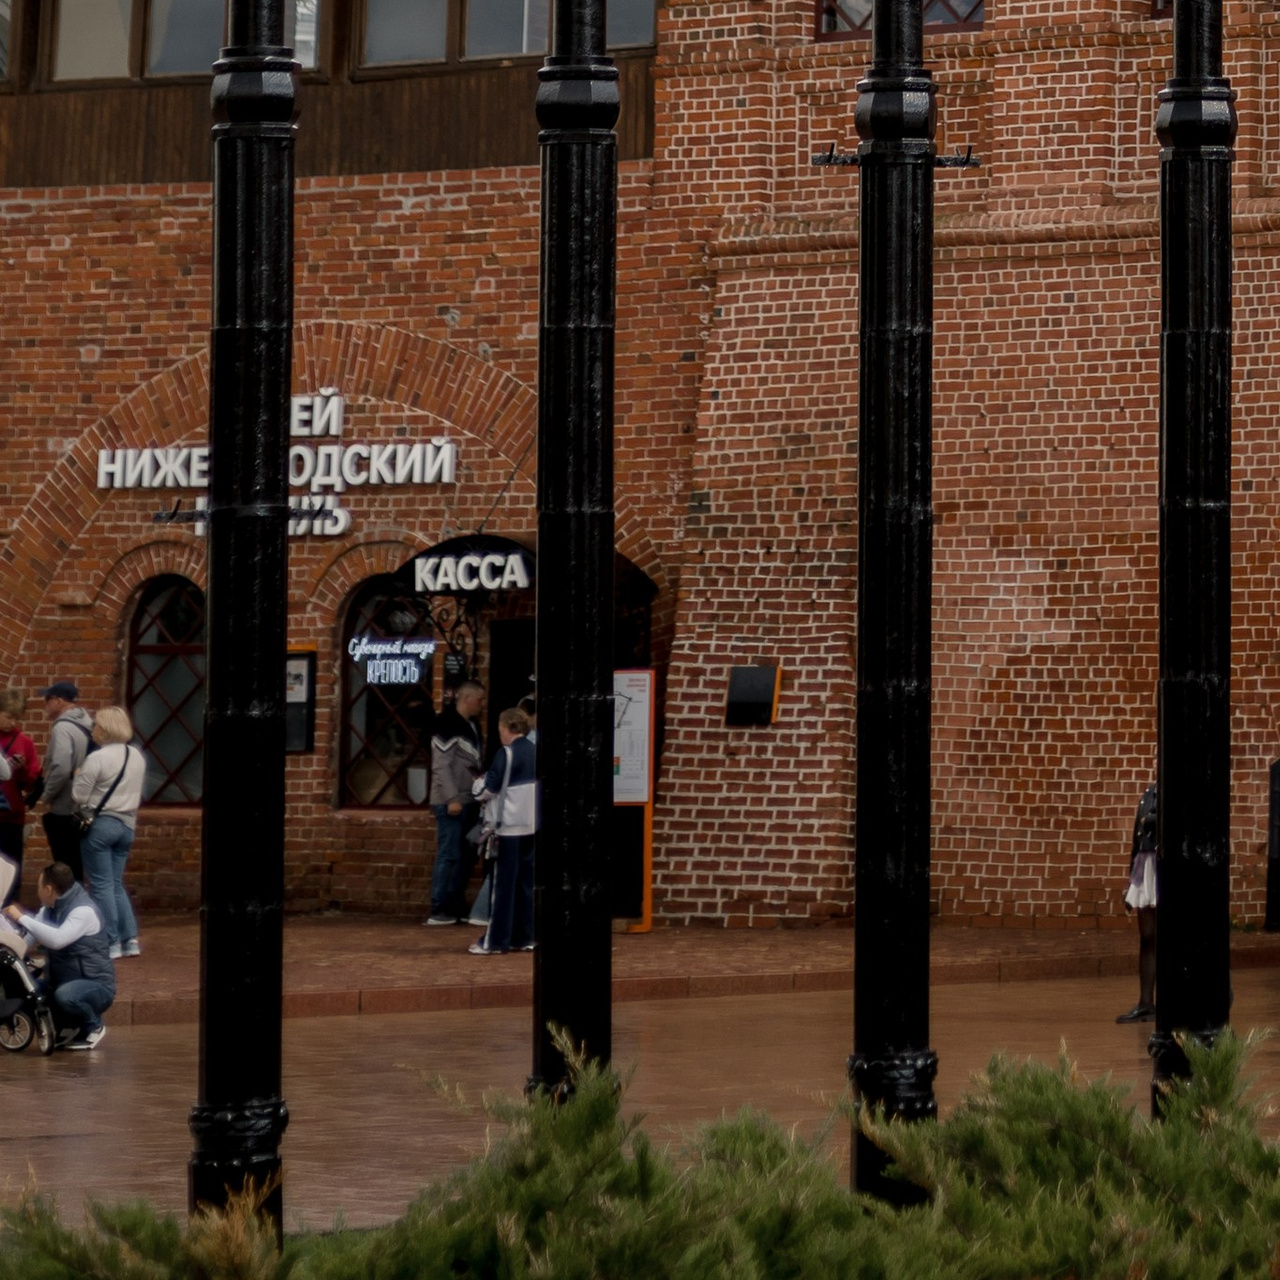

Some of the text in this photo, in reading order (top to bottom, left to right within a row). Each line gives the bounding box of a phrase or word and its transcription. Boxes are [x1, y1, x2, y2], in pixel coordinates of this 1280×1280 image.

[98, 437, 456, 492] НИЖЕОДСКИЙ
[415, 553, 531, 593] КАССА
[366, 658, 420, 684] КРЕПОСТЬ
